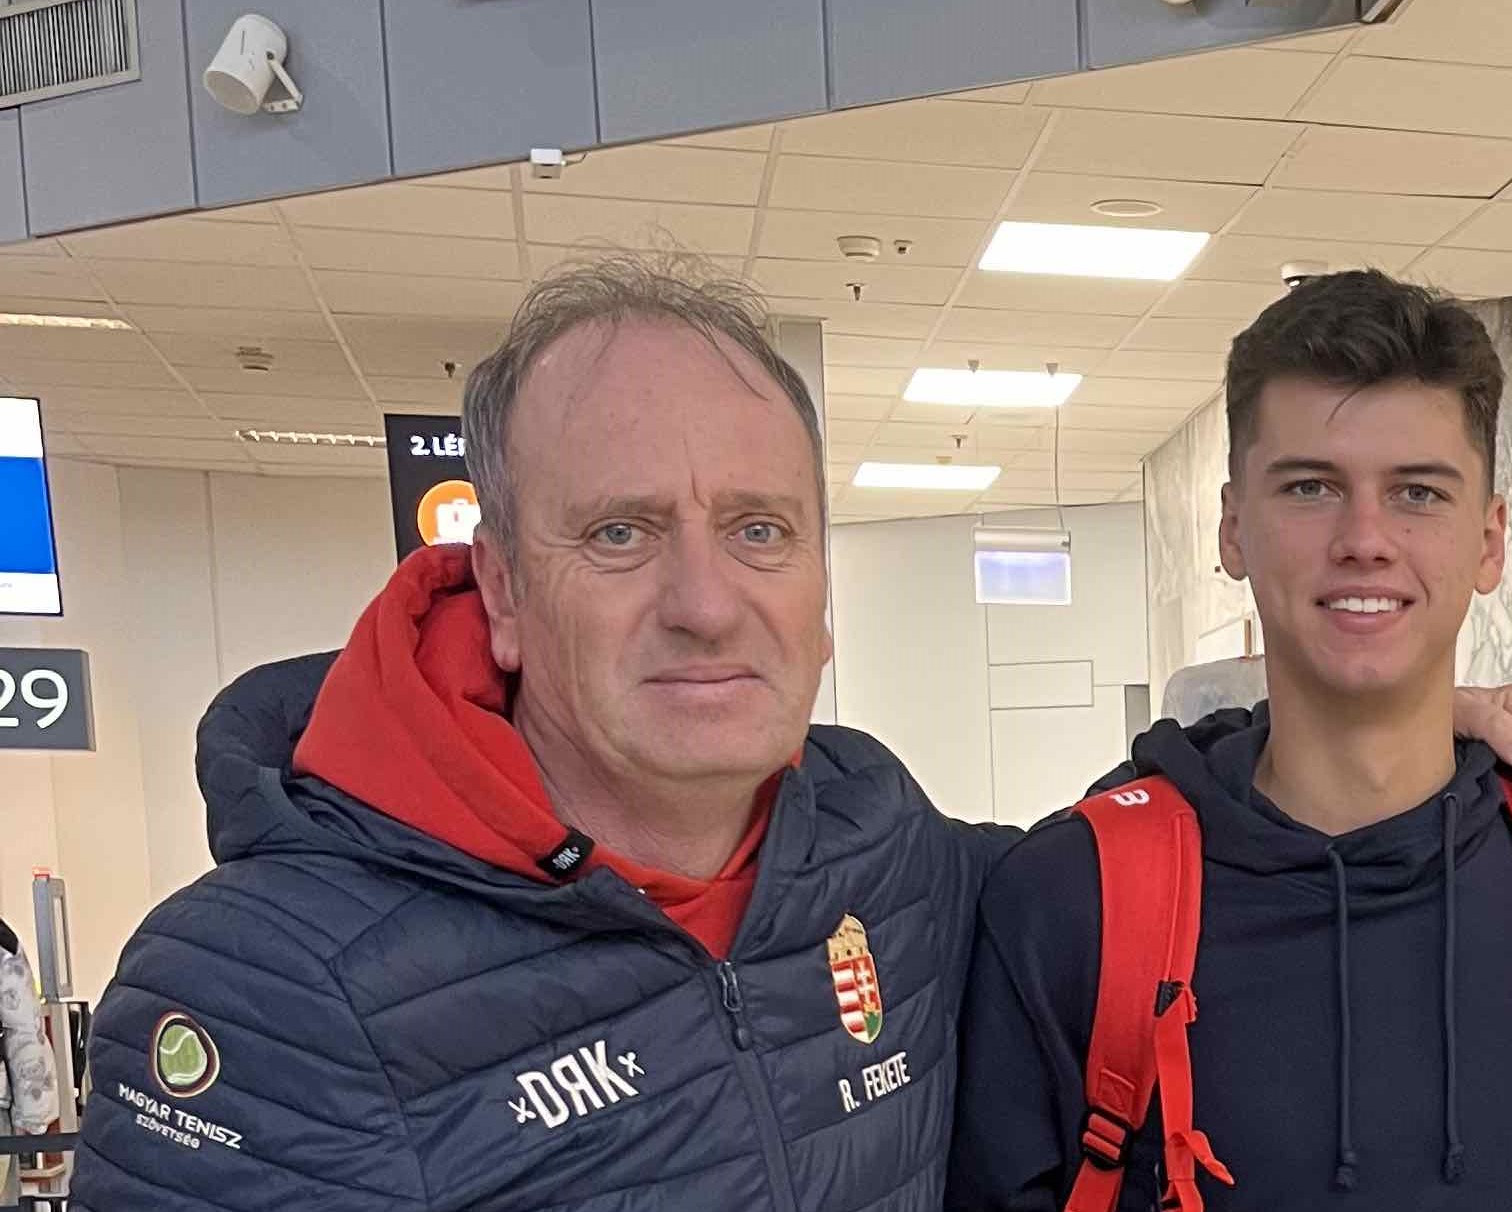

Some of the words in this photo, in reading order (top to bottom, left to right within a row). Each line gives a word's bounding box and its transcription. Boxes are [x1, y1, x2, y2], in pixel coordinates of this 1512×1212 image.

[838, 1078, 861, 1113] R.
[861, 1051, 912, 1101] FEKETE
[118, 1082, 172, 1121] MAGYAR
[174, 1109, 243, 1149] TENISZ
